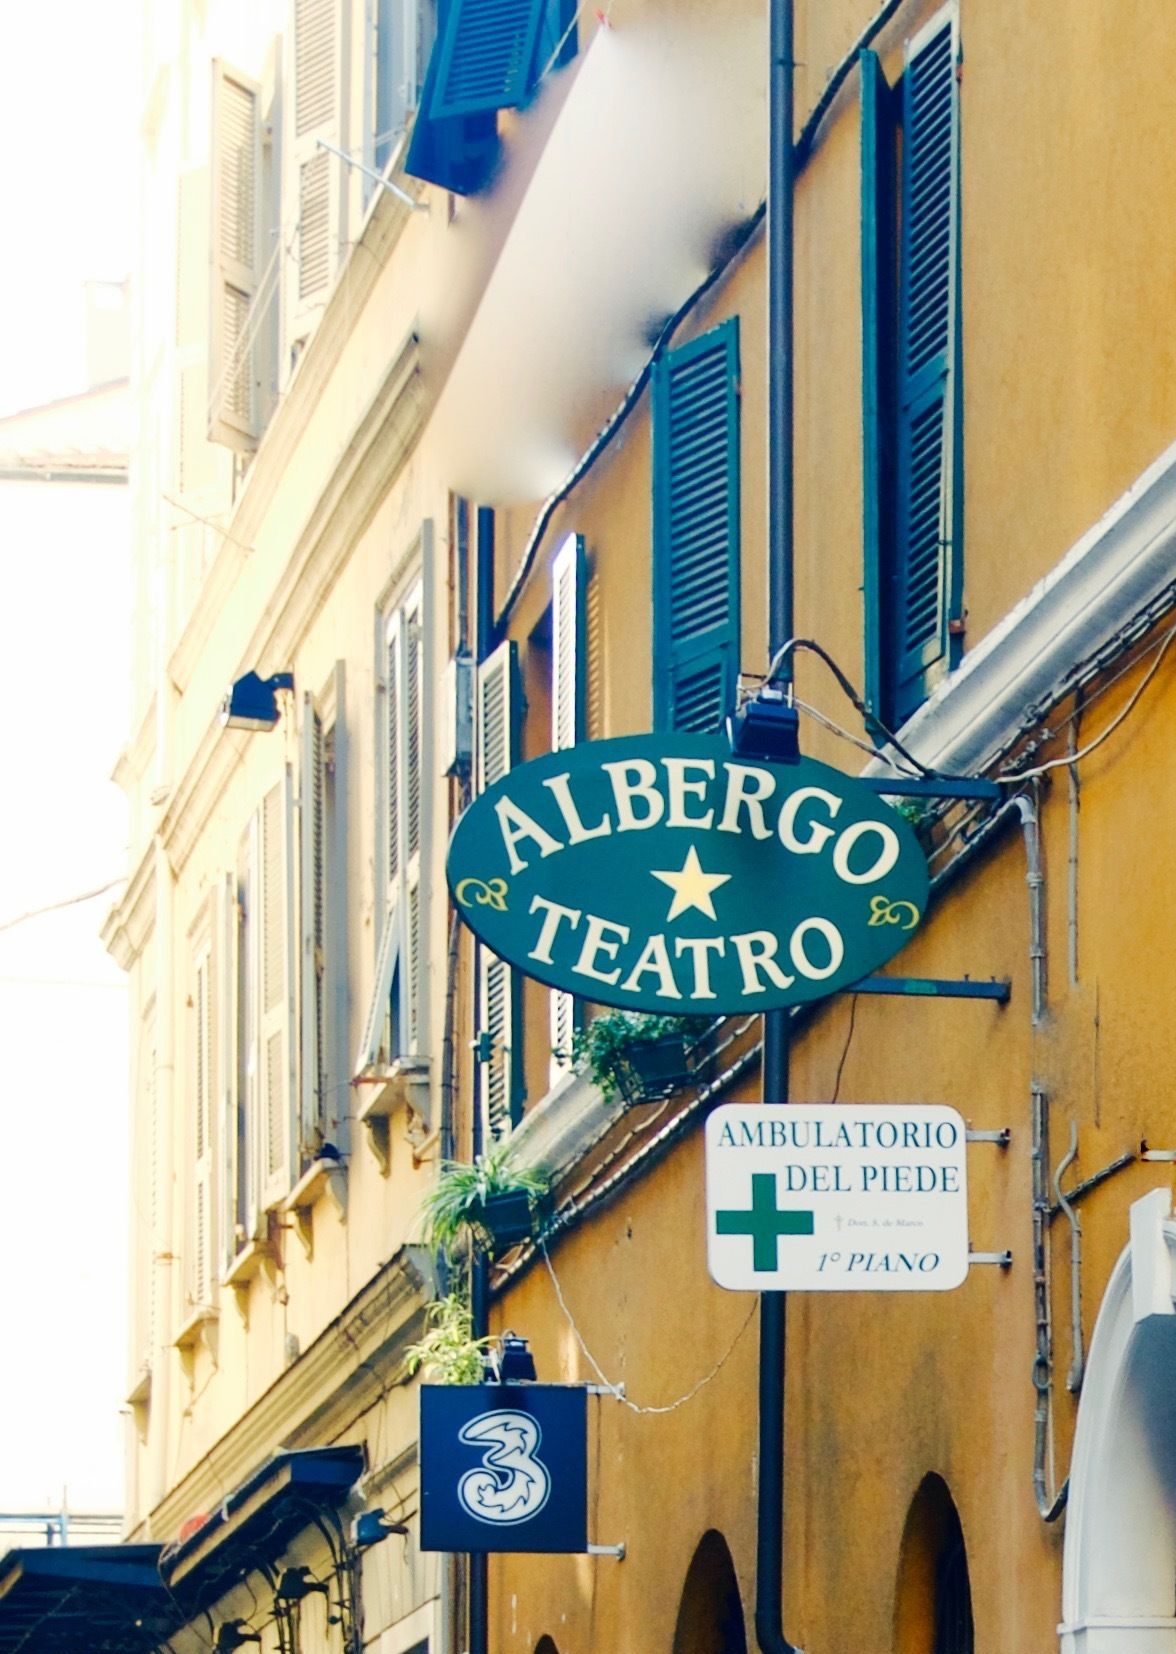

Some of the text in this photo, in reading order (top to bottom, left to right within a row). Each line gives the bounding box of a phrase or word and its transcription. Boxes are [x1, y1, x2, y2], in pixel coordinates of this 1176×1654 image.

[492, 756, 900, 886] ALBERGO
[526, 894, 845, 1000] TEATRO
[716, 1119, 958, 1149] AMBULATORIO
[785, 1163, 960, 1194] DEL PIEDE
[816, 1252, 940, 1273] 1° PIANO
[457, 1408, 551, 1526] 3
